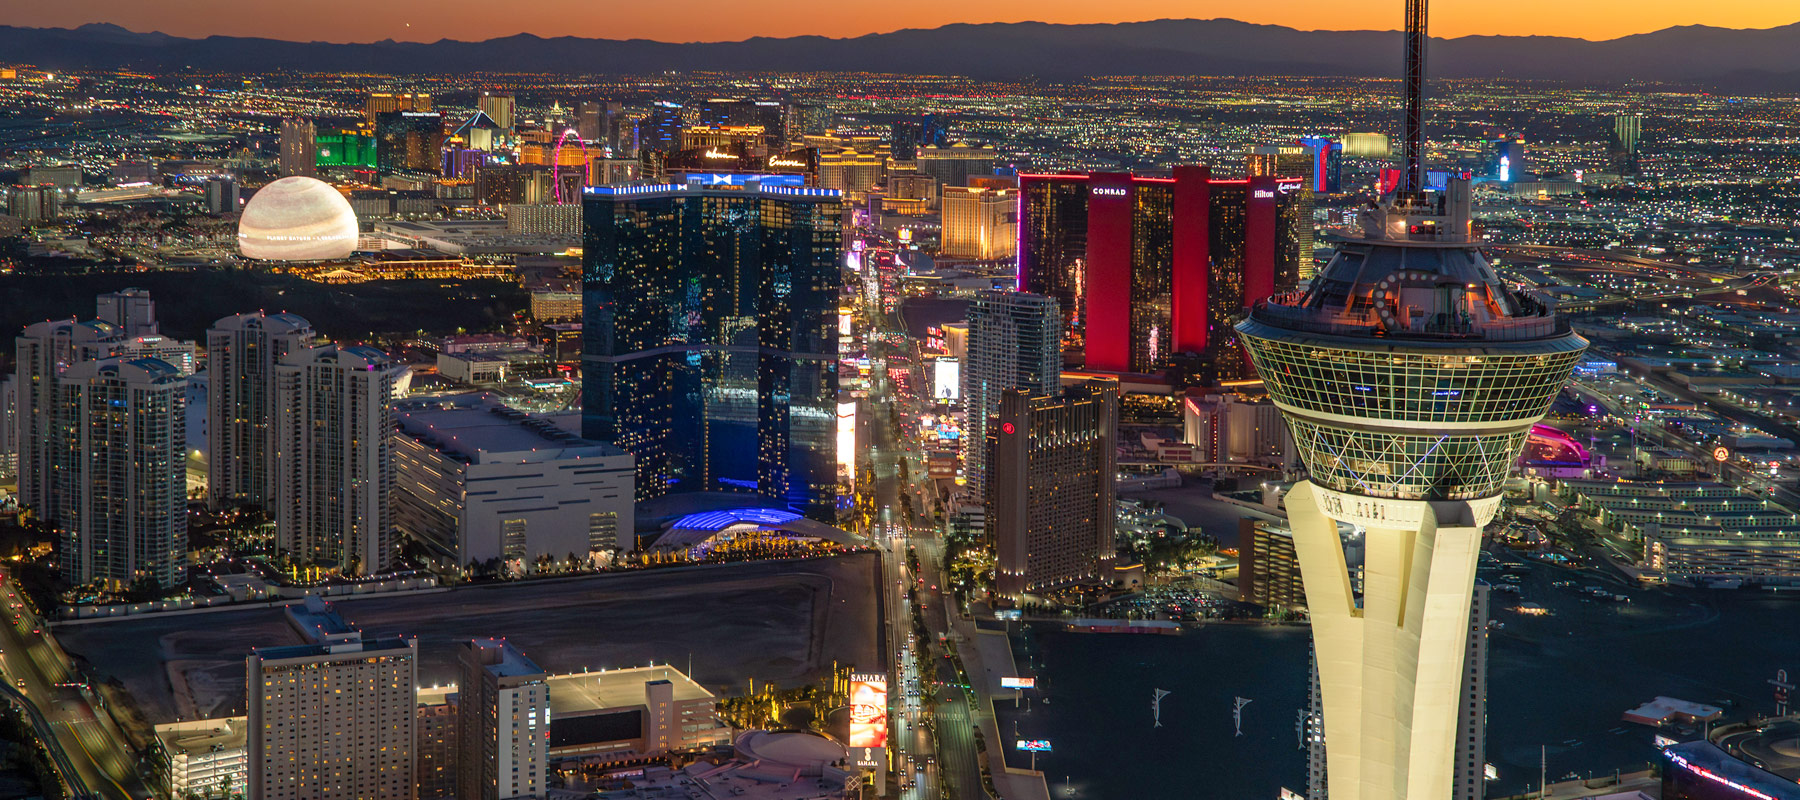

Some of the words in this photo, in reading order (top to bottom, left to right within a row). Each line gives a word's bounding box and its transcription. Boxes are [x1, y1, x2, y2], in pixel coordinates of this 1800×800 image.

[1278, 146, 1304, 155] TRUMP
[769, 154, 805, 167] Encore
[1092, 187, 1126, 196] CONRAD
[1254, 190, 1274, 199] Hilton
[850, 674, 886, 682] SAHARA
